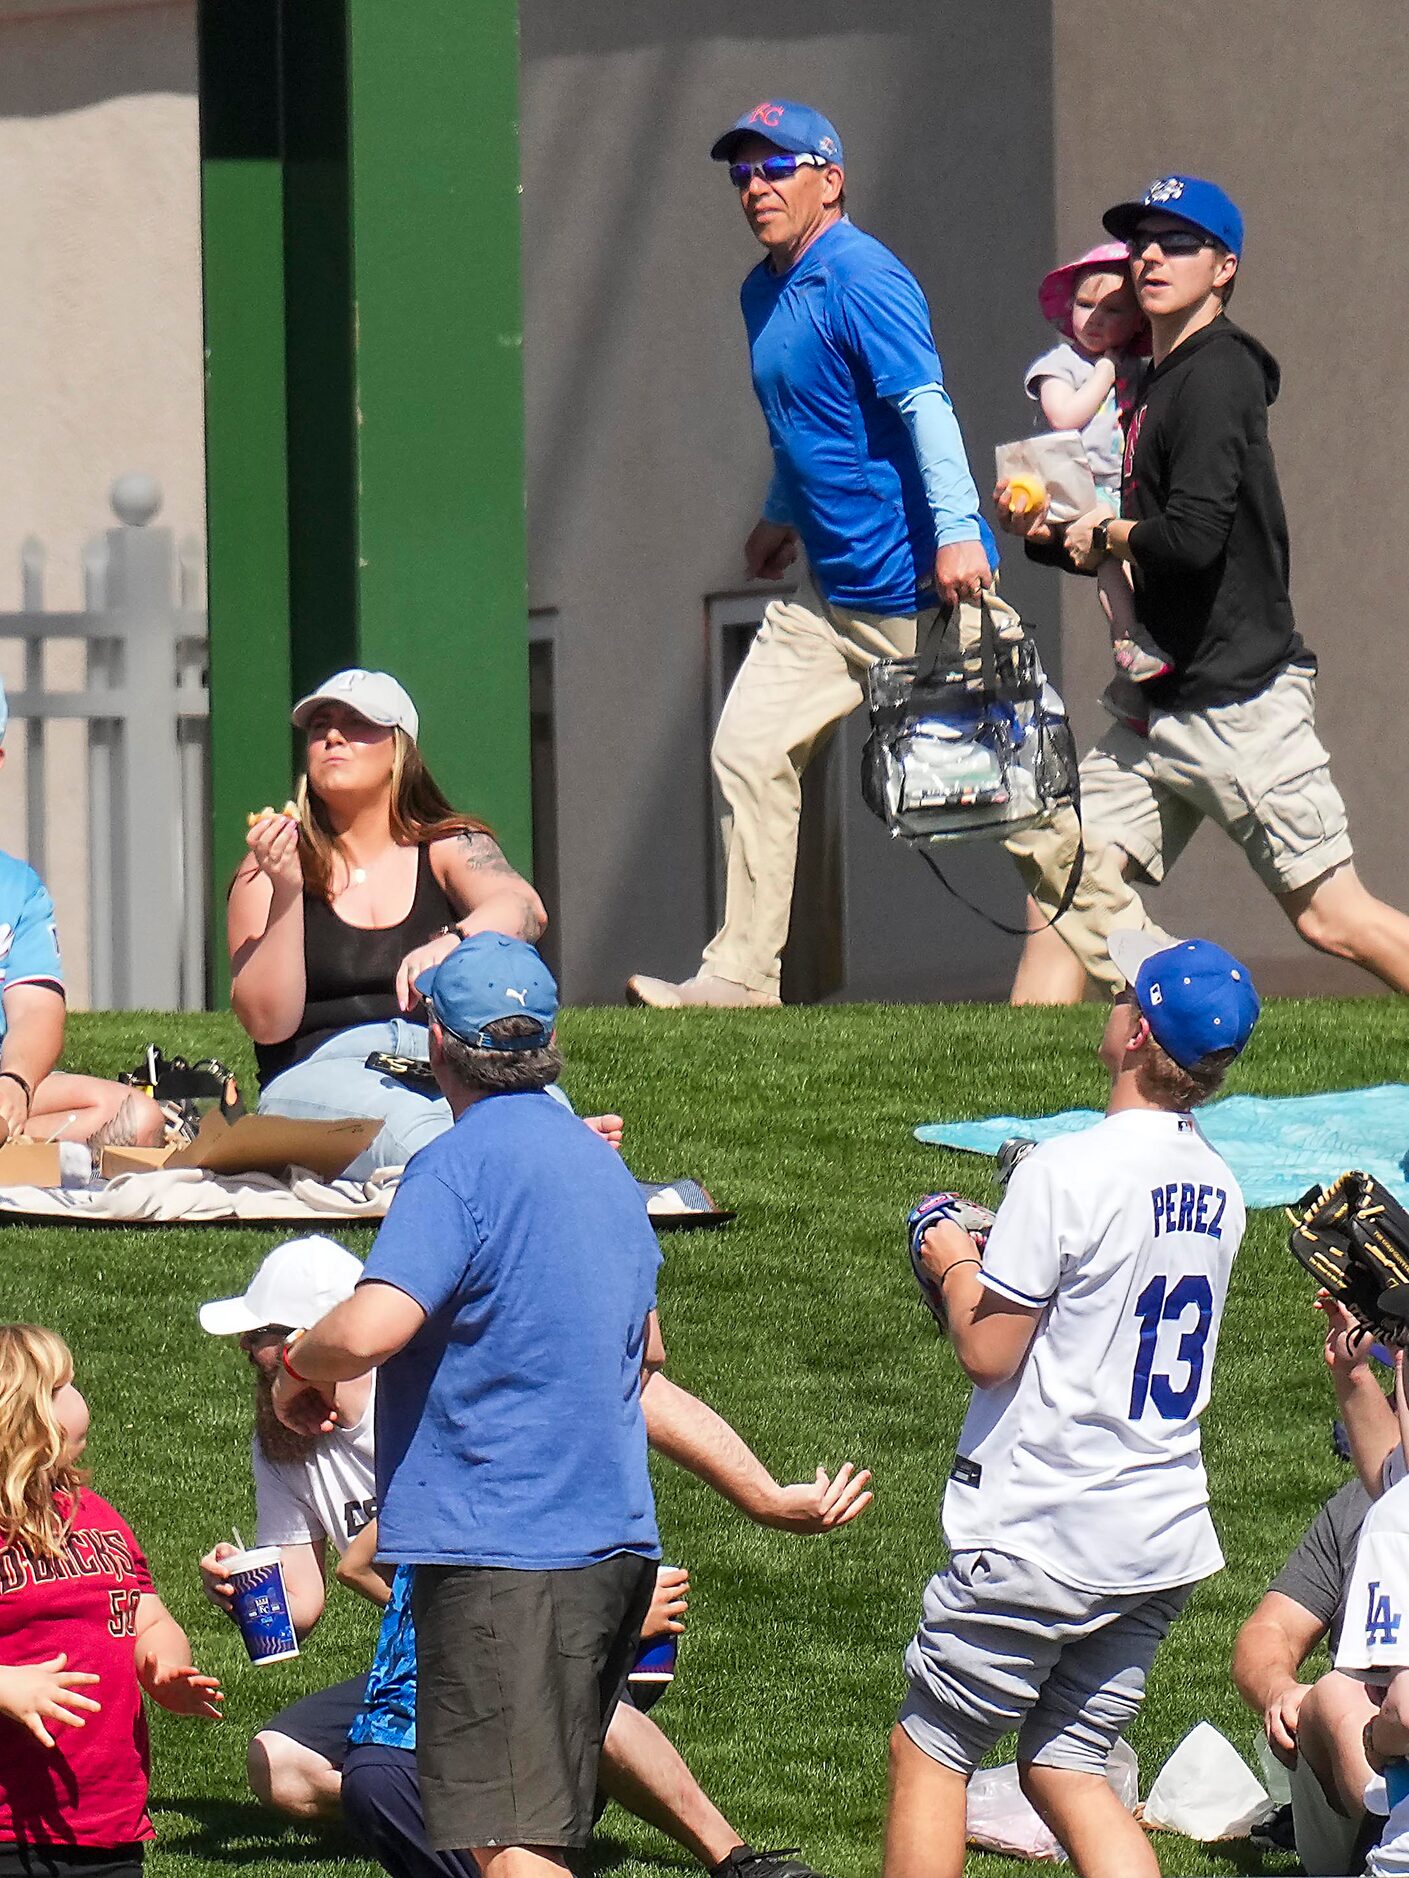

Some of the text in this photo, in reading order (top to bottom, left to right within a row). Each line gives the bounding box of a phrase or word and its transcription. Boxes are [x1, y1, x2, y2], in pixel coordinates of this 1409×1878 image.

[748, 103, 785, 128] KC
[1151, 1183, 1227, 1240] PEREZ
[1128, 1275, 1213, 1421] 13
[1365, 1582, 1402, 1646] LA
